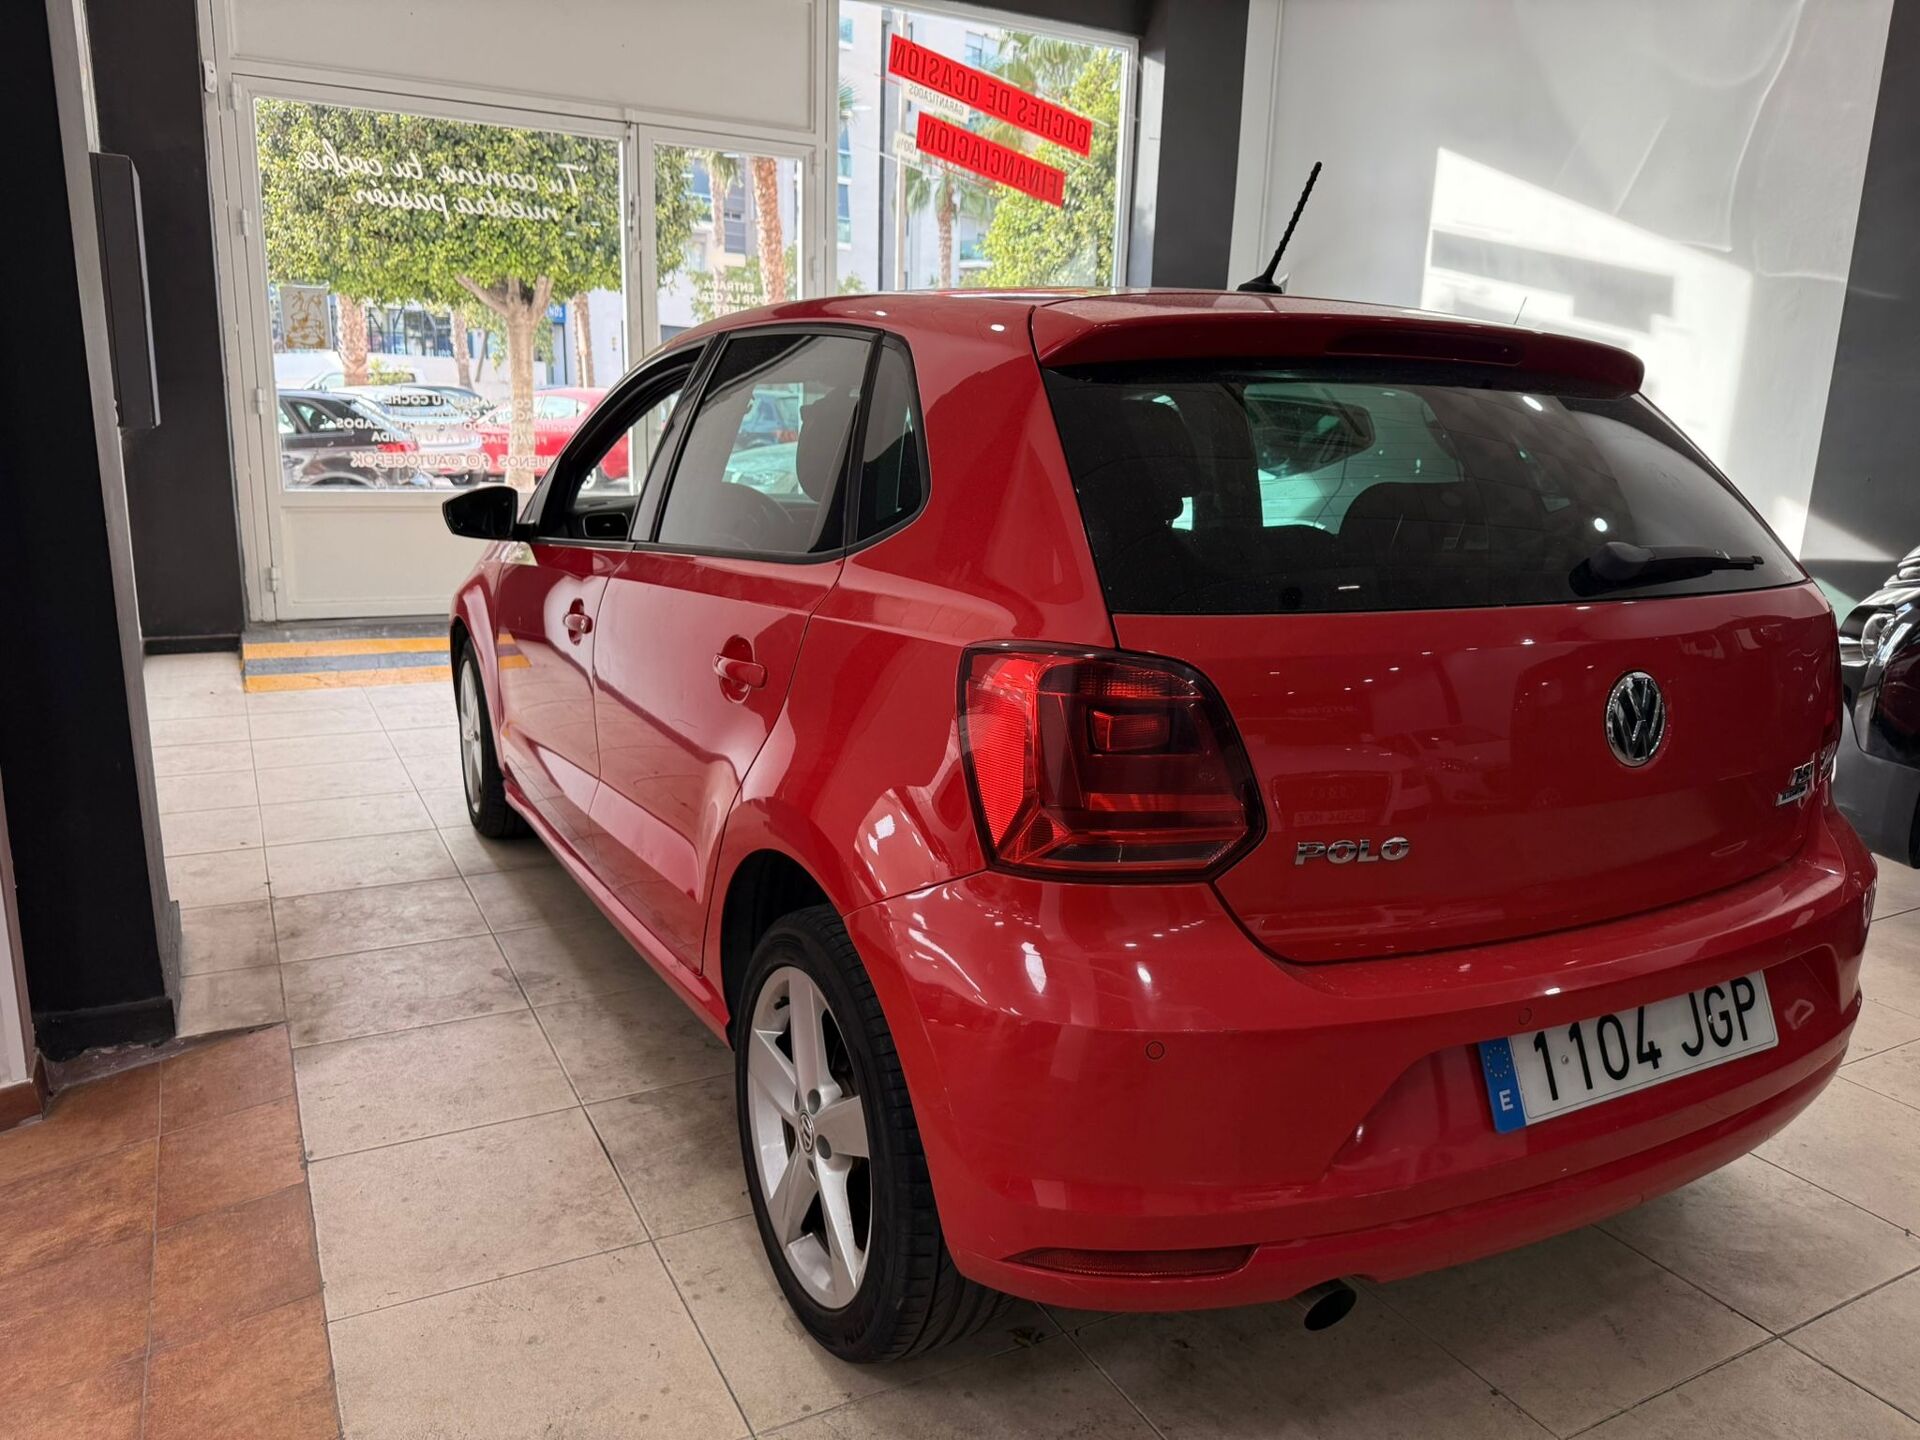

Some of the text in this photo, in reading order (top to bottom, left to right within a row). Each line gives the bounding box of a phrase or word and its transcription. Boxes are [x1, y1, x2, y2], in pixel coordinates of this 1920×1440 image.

[1294, 836, 1411, 866] POLO
[1532, 976, 1756, 1101] 1104 JGP
[1498, 1088, 1514, 1111] E
